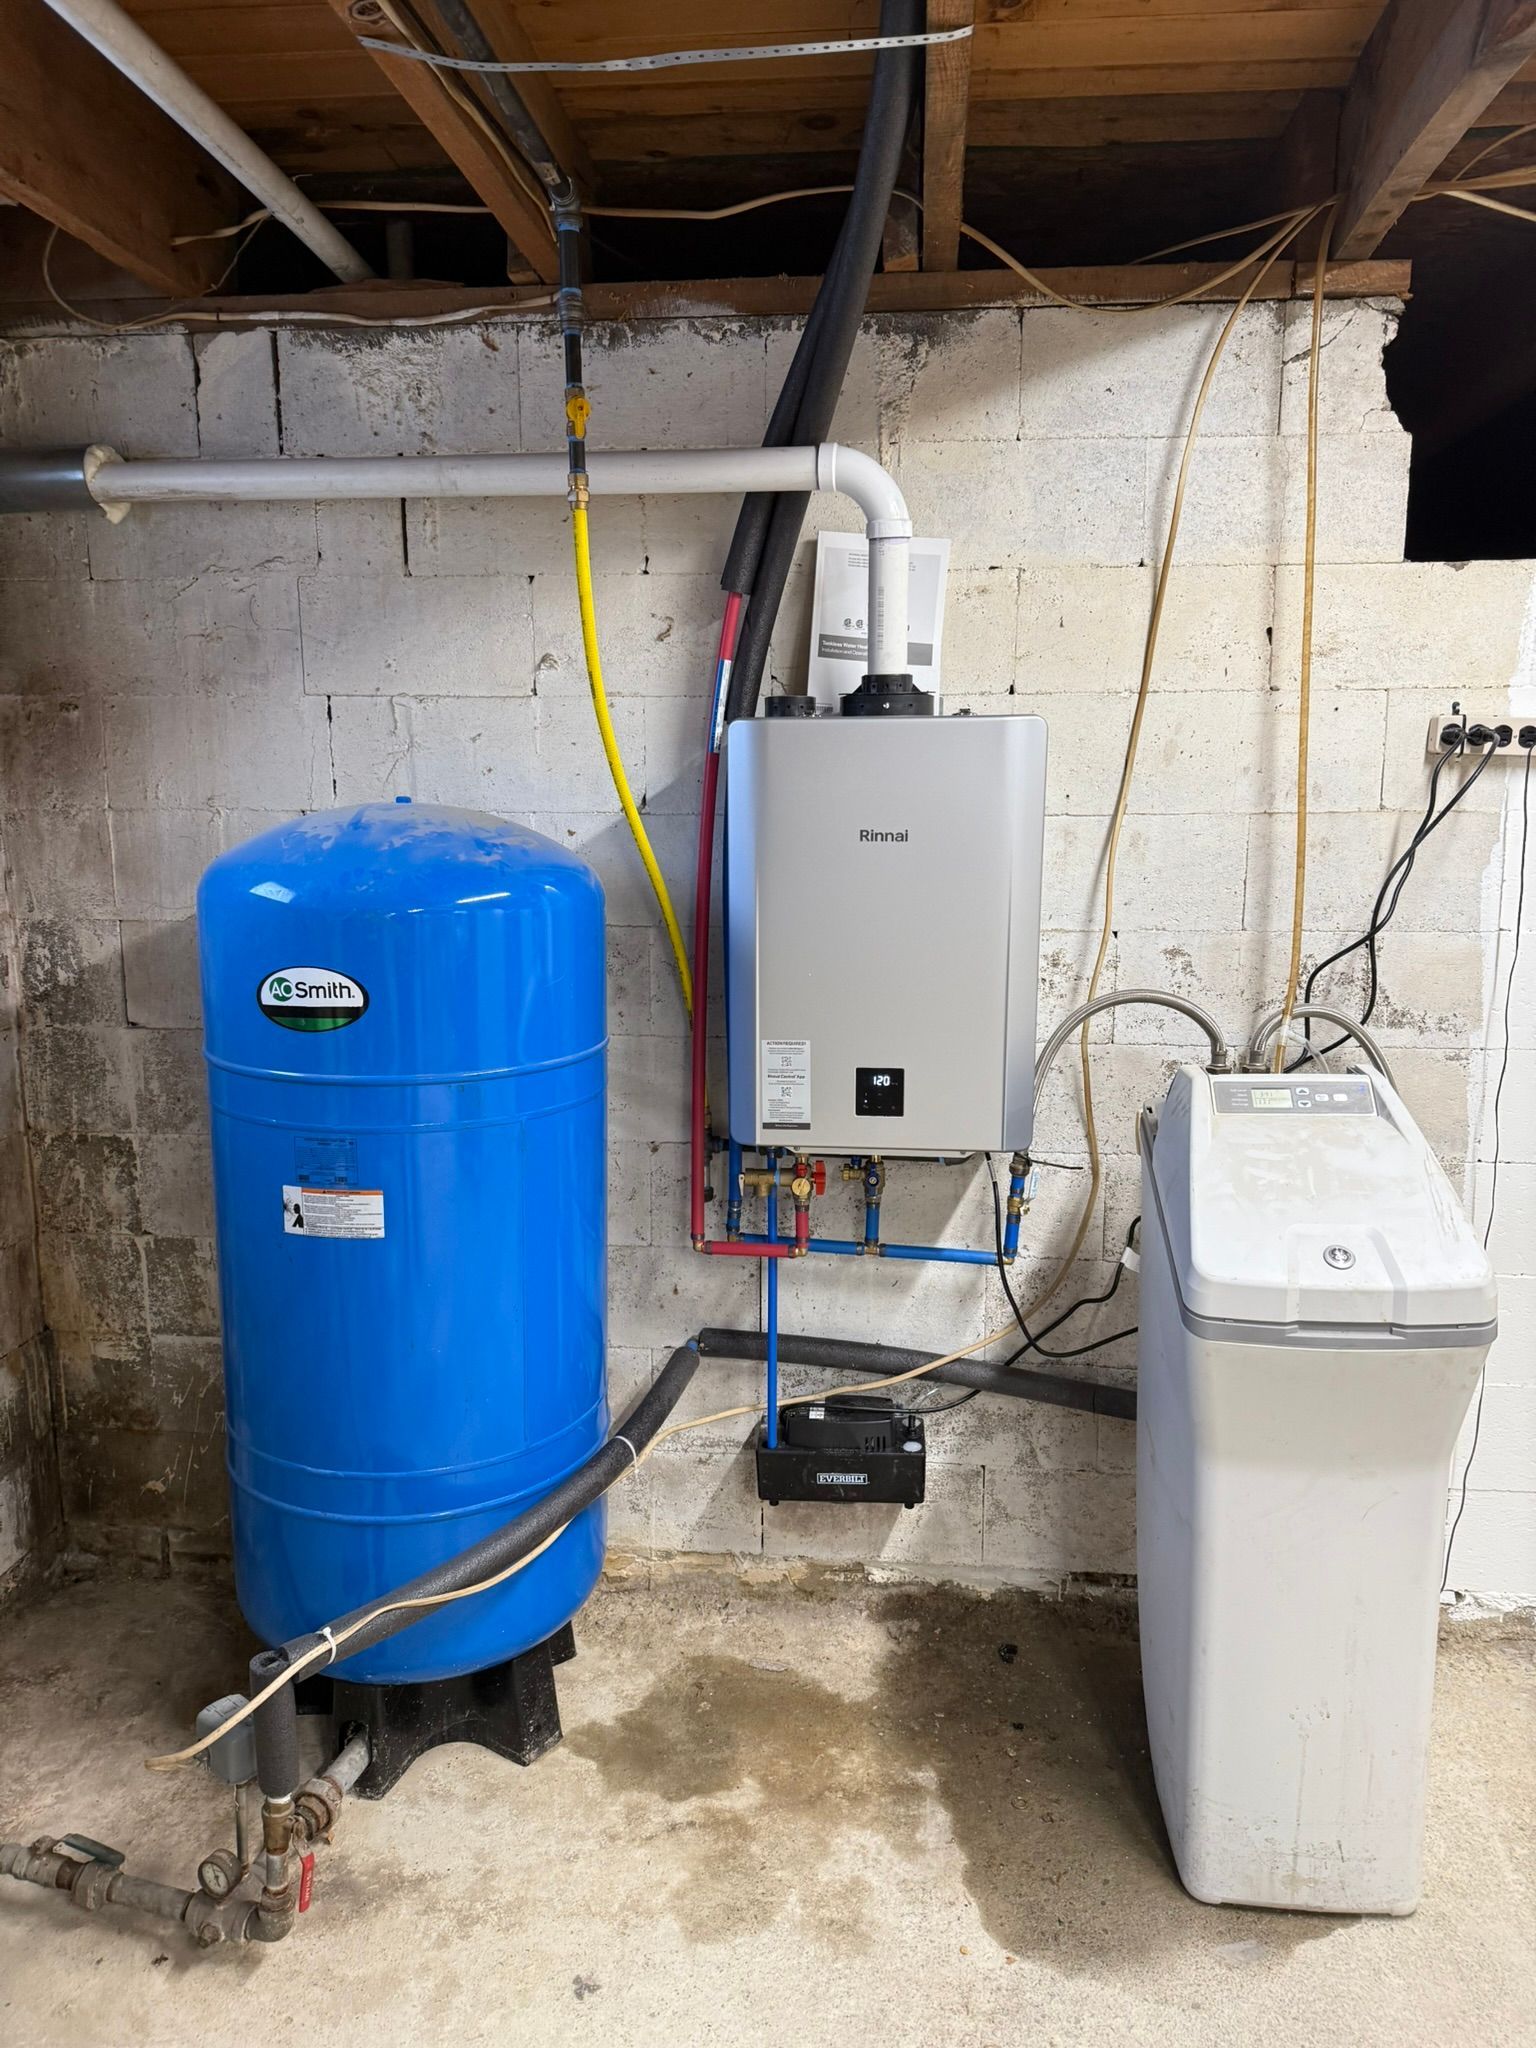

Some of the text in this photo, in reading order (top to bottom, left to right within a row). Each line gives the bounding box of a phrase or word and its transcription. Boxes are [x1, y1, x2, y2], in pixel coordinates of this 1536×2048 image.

[860, 829, 908, 842] Rinnai
[295, 982, 352, 998] Smith
[873, 1075, 890, 1087] 120
[820, 1475, 865, 1483] EVERBILT
